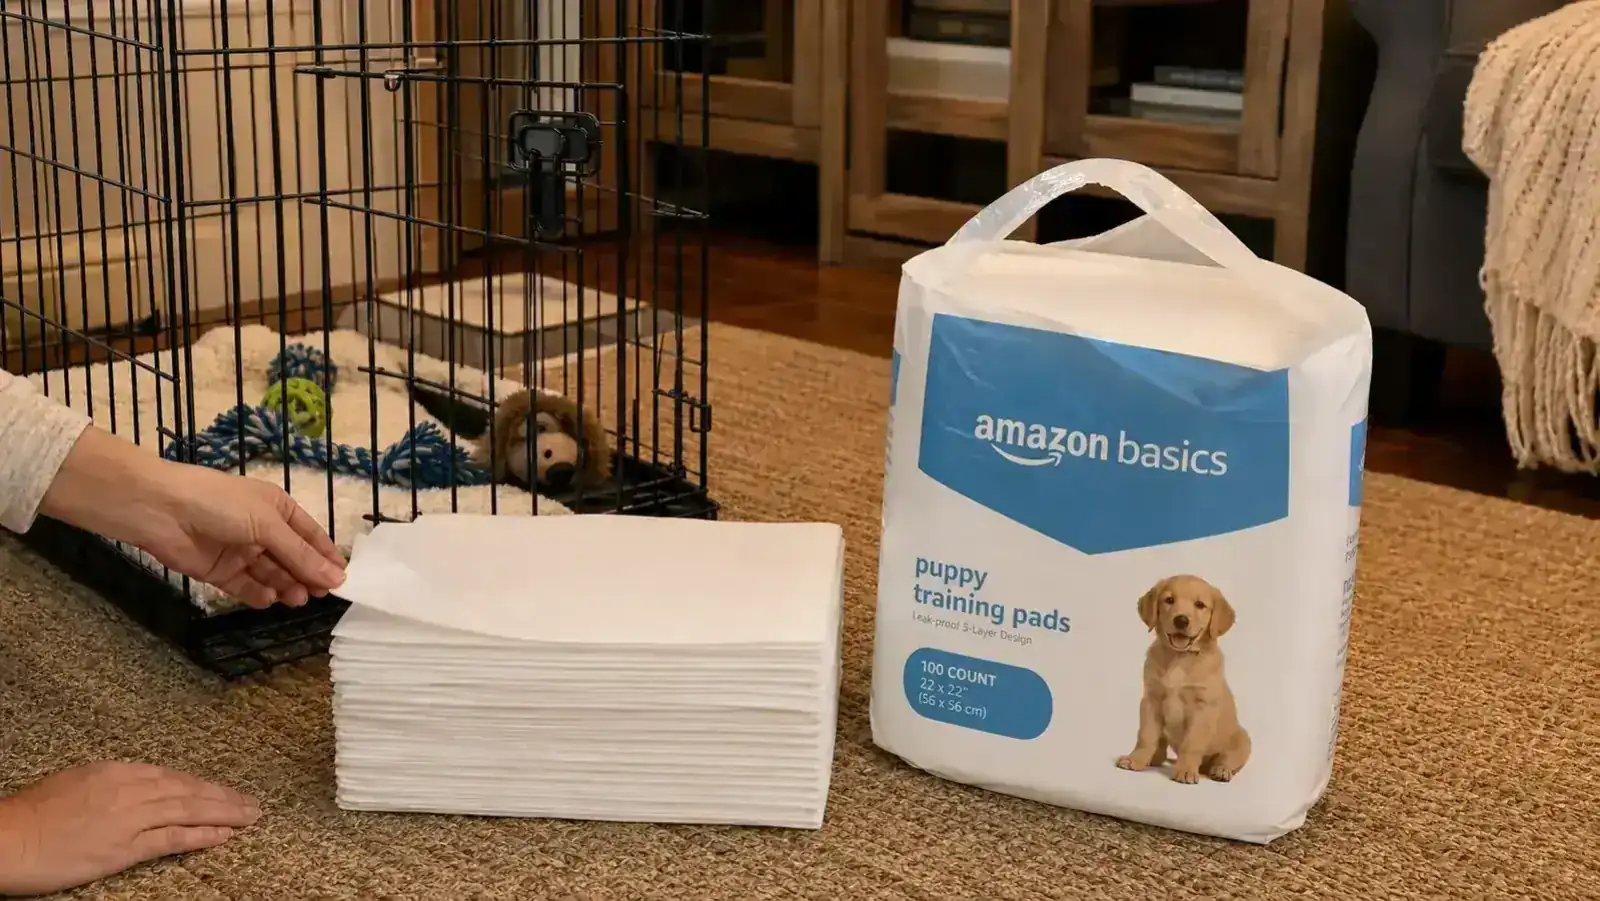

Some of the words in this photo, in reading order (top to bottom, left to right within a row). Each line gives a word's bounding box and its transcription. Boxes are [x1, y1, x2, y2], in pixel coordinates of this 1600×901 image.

[974, 413, 1109, 466] amazon
[1117, 431, 1229, 477] basics
[915, 556, 988, 591] puppy
[913, 583, 1005, 625] training
[1012, 606, 1071, 633] pads
[912, 610, 960, 631] Leak-proof
[999, 630, 1033, 646] Design
[920, 660, 944, 676] 100
[947, 666, 997, 688] COUNT
[920, 677, 936, 692] 22
[937, 683, 945, 694] x
[917, 691, 936, 707] (56
[938, 698, 945, 709] x
[947, 699, 963, 713] 56
[964, 704, 988, 720] cm)
